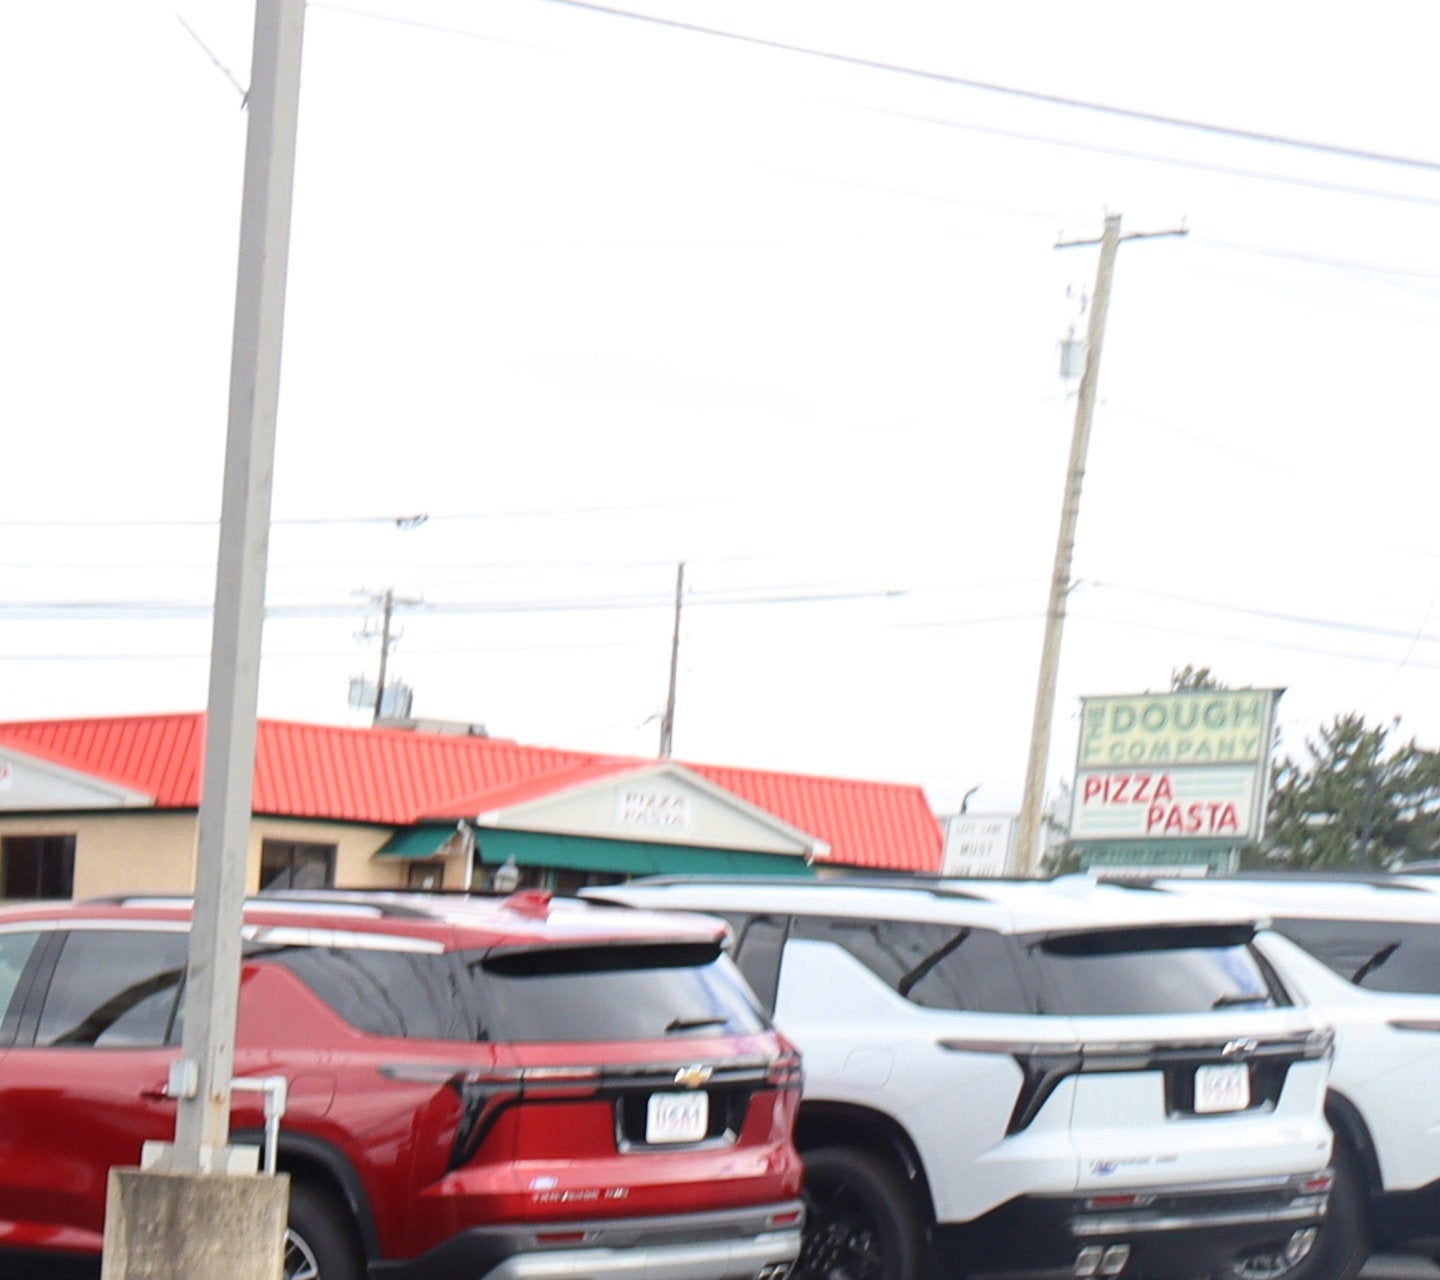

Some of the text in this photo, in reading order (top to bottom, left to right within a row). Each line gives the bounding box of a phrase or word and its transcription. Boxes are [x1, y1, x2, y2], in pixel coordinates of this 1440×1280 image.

[1111, 700, 1260, 734] DOUGH
[1108, 737, 1257, 761] COMPANY
[1084, 773, 1173, 804] PIZZA
[1146, 802, 1239, 833] PASTA
